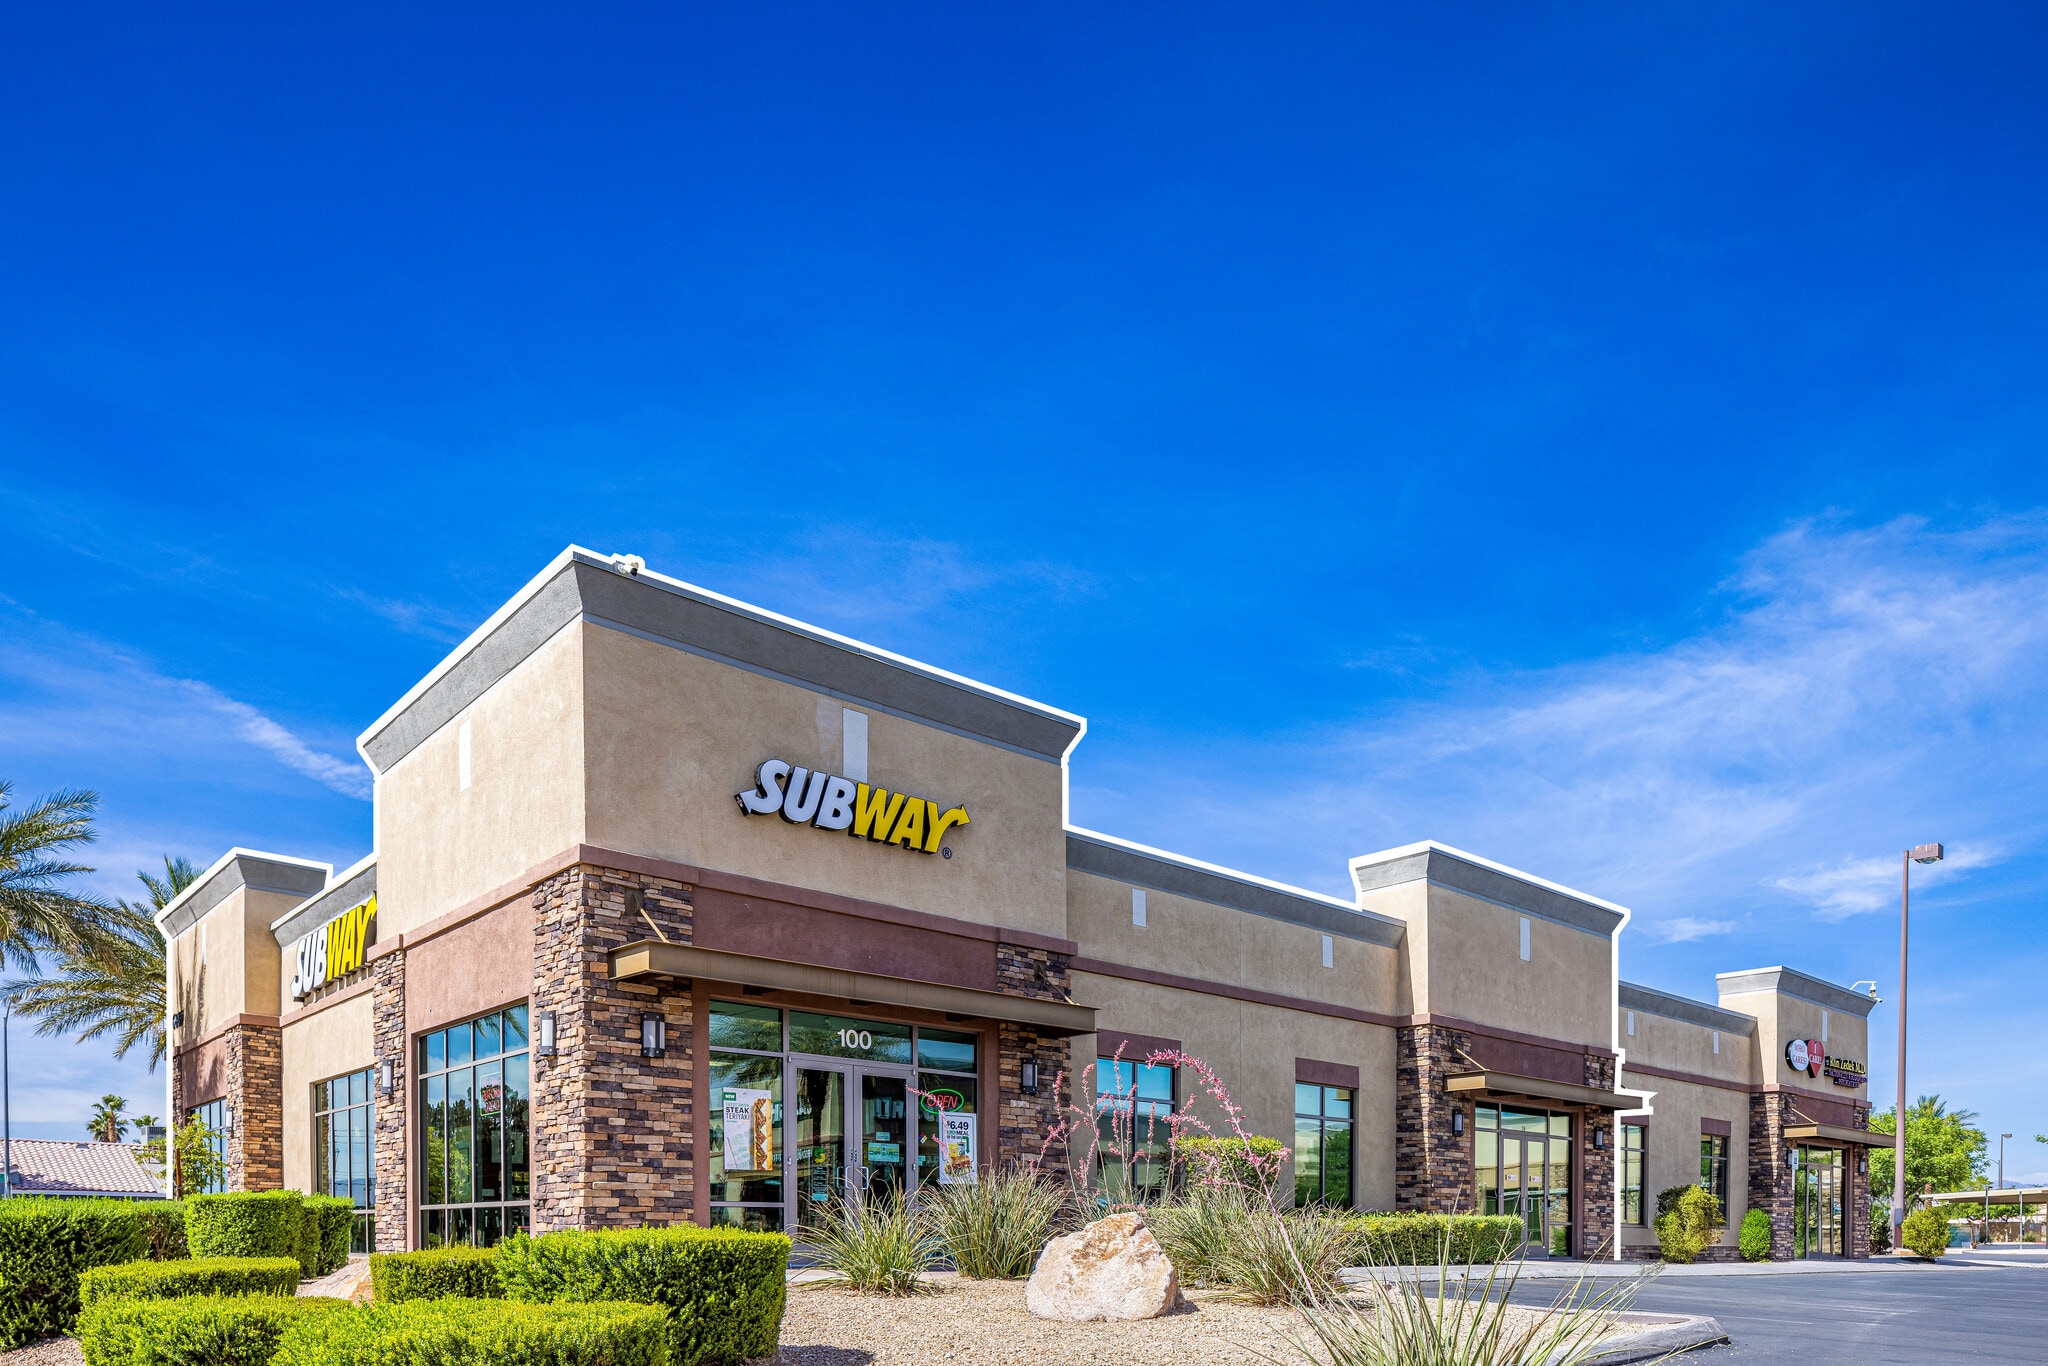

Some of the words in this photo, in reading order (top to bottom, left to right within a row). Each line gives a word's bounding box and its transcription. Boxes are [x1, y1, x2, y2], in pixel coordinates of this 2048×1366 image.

[734, 759, 971, 854] SUBWAY
[290, 890, 377, 1000] SUBWAY
[837, 1029, 872, 1050] 100
[926, 1094, 958, 1109] OPEN
[947, 1121, 969, 1130] $6.49
